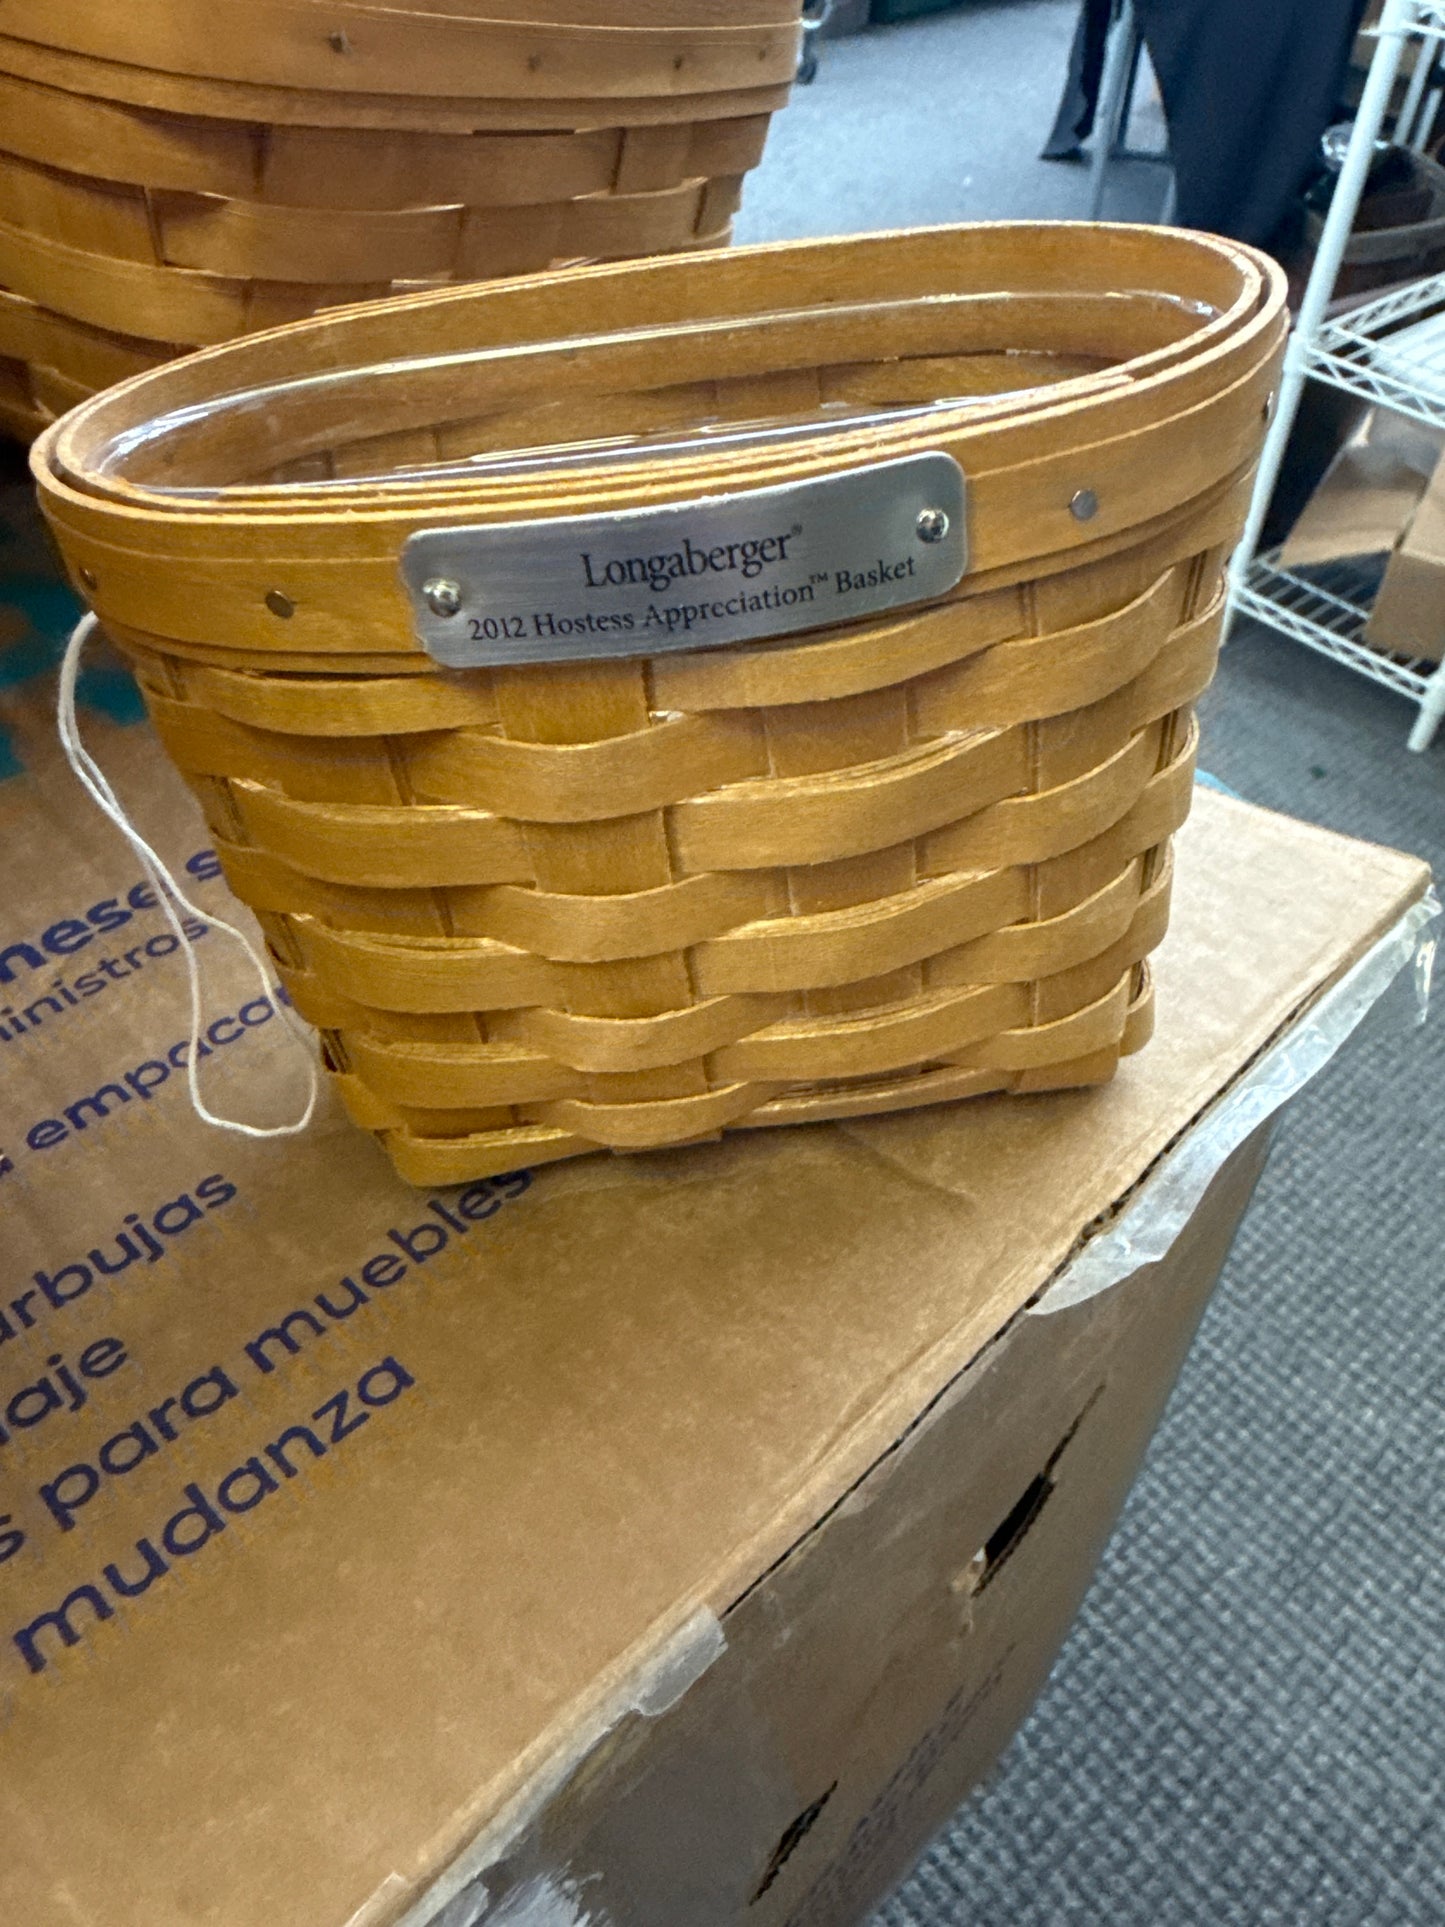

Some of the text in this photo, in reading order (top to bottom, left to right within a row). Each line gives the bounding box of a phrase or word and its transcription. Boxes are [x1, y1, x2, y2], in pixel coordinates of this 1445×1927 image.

[468, 616, 527, 641] 2012
[535, 609, 636, 637] Hostess
[836, 555, 915, 594] Basket
[39, 1169, 533, 1533] para muebles
[12, 1355, 415, 1673] mudanza
